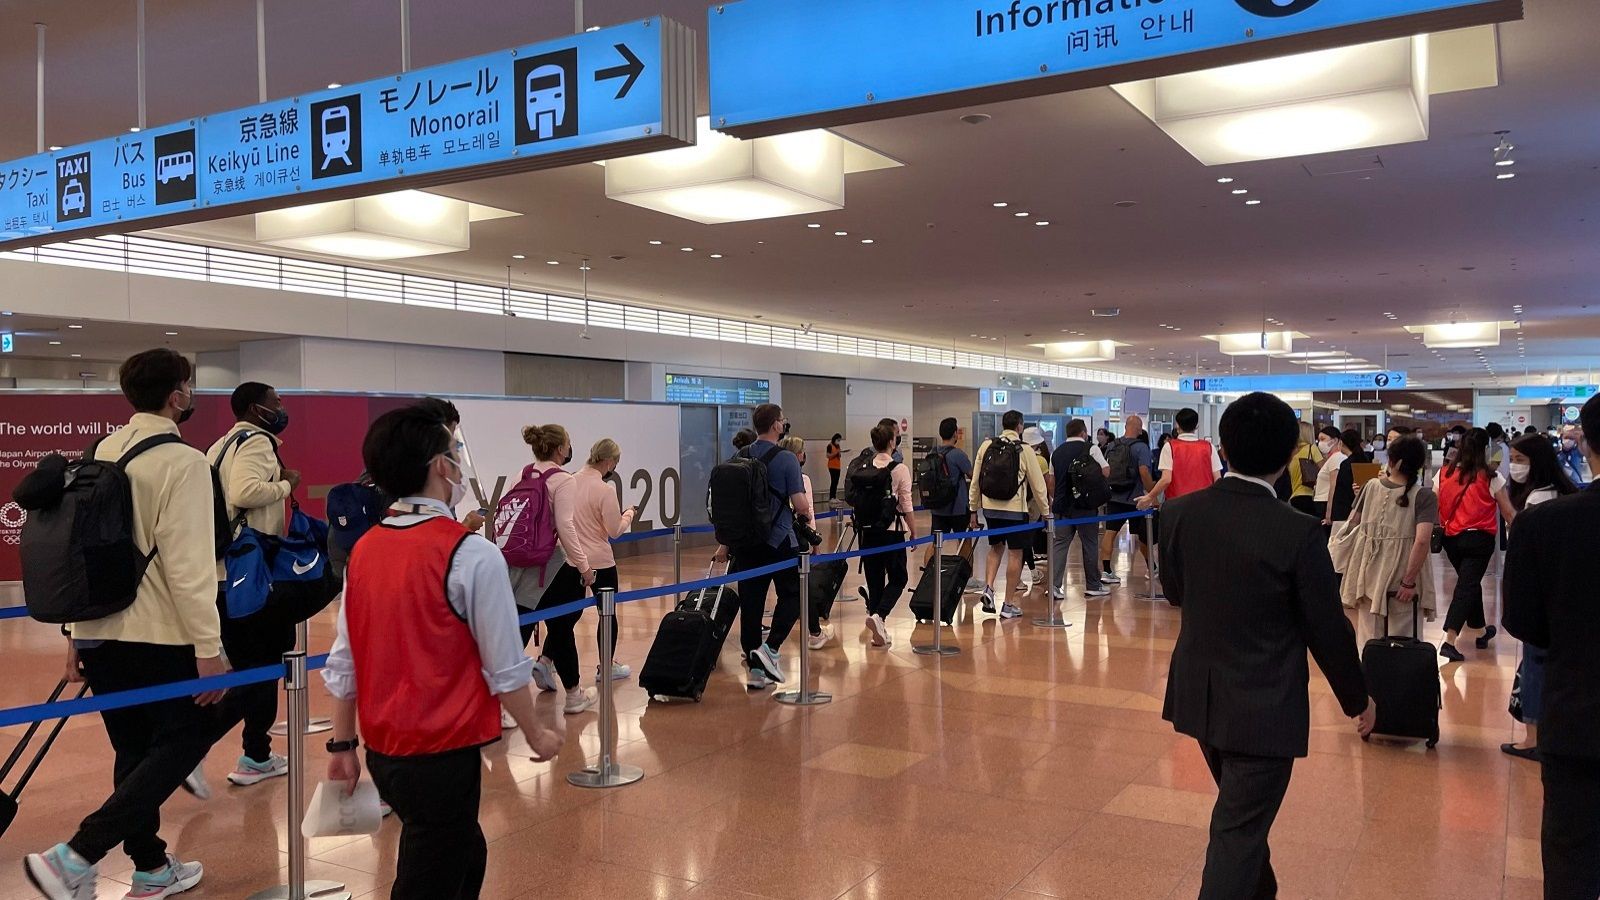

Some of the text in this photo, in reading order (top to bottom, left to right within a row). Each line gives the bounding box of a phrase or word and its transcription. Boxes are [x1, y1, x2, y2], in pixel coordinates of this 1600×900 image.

[976, 0, 1164, 37] Informa
[1067, 8, 1193, 55] 问讯 안내
[379, 67, 499, 113] モノレール
[240, 108, 299, 143] 京急線
[410, 100, 499, 138] Monorail
[114, 142, 145, 167] バス
[208, 142, 299, 175] Keikyū Line
[379, 130, 500, 167] 单轨电车 모노레일
[58, 156, 88, 178] TAXI
[254, 166, 300, 187] 게이큐선
[0, 168, 48, 191] タクシー
[123, 172, 146, 190] Bus
[26, 188, 48, 209] Taxi
[102, 195, 146, 213] 巴士 버스
[0, 422, 26, 435] The
[30, 422, 72, 435] world
[77, 422, 101, 435] will
[0, 449, 23, 459] apan
